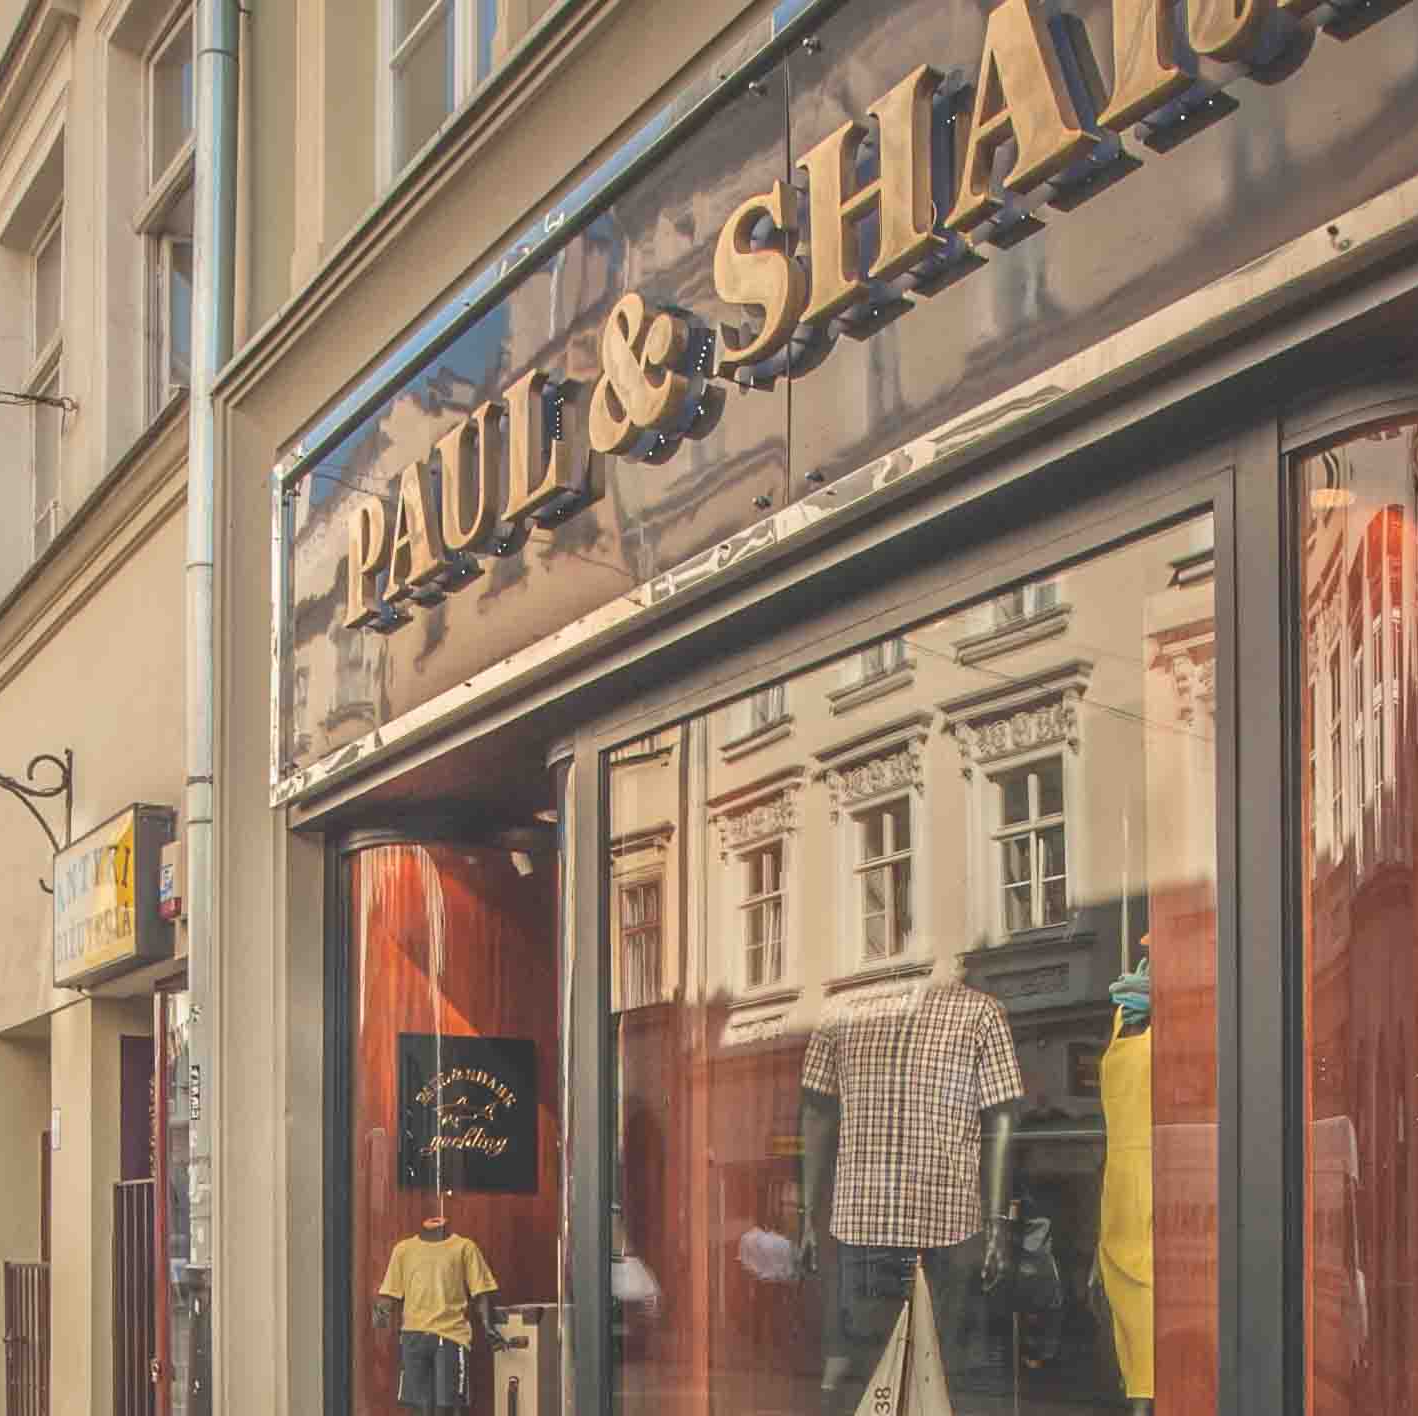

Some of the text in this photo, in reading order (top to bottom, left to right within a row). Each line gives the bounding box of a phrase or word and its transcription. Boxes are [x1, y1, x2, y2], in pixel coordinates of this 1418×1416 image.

[344, 0, 1321, 630] PAUL & SHA
